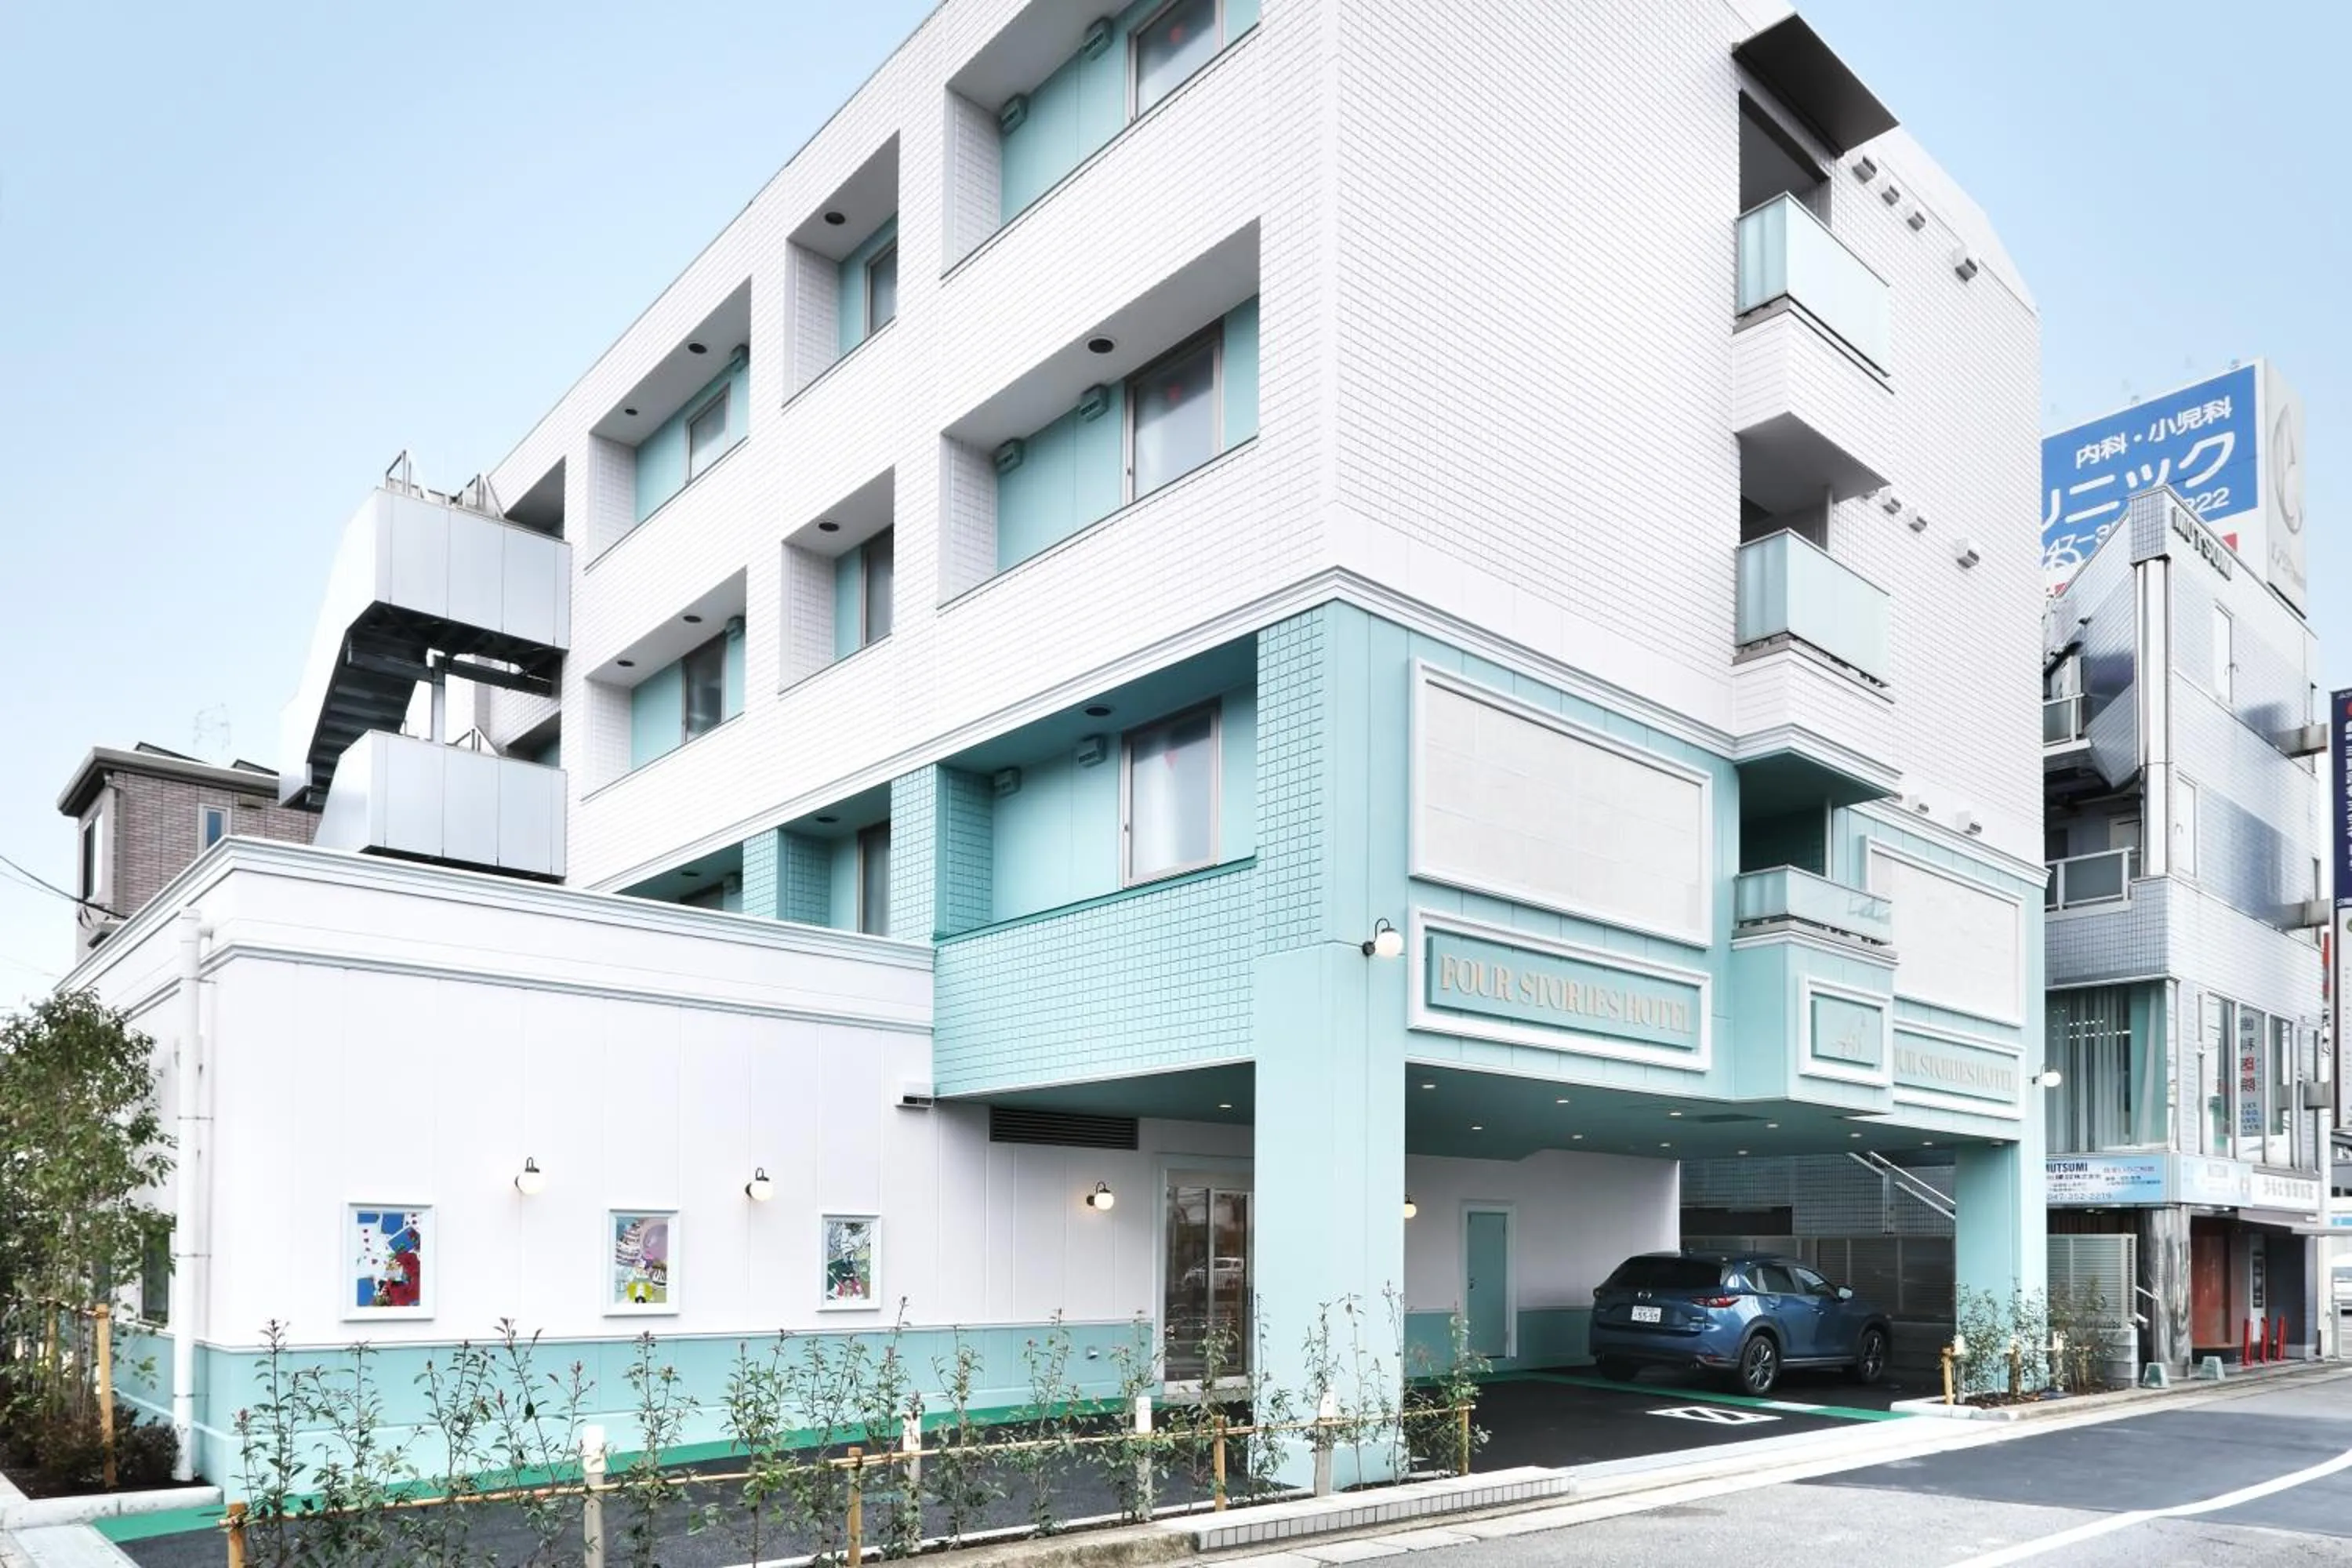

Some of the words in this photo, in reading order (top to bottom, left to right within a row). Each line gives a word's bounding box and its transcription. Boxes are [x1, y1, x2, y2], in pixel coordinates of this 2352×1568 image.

[2075, 395, 2233, 470] 内科・小児科
[1441, 953, 1513, 1002] FOUR
[1518, 971, 1621, 1018] STORIES
[1623, 989, 1693, 1034] HOTEL
[1894, 1047, 1918, 1076] UR
